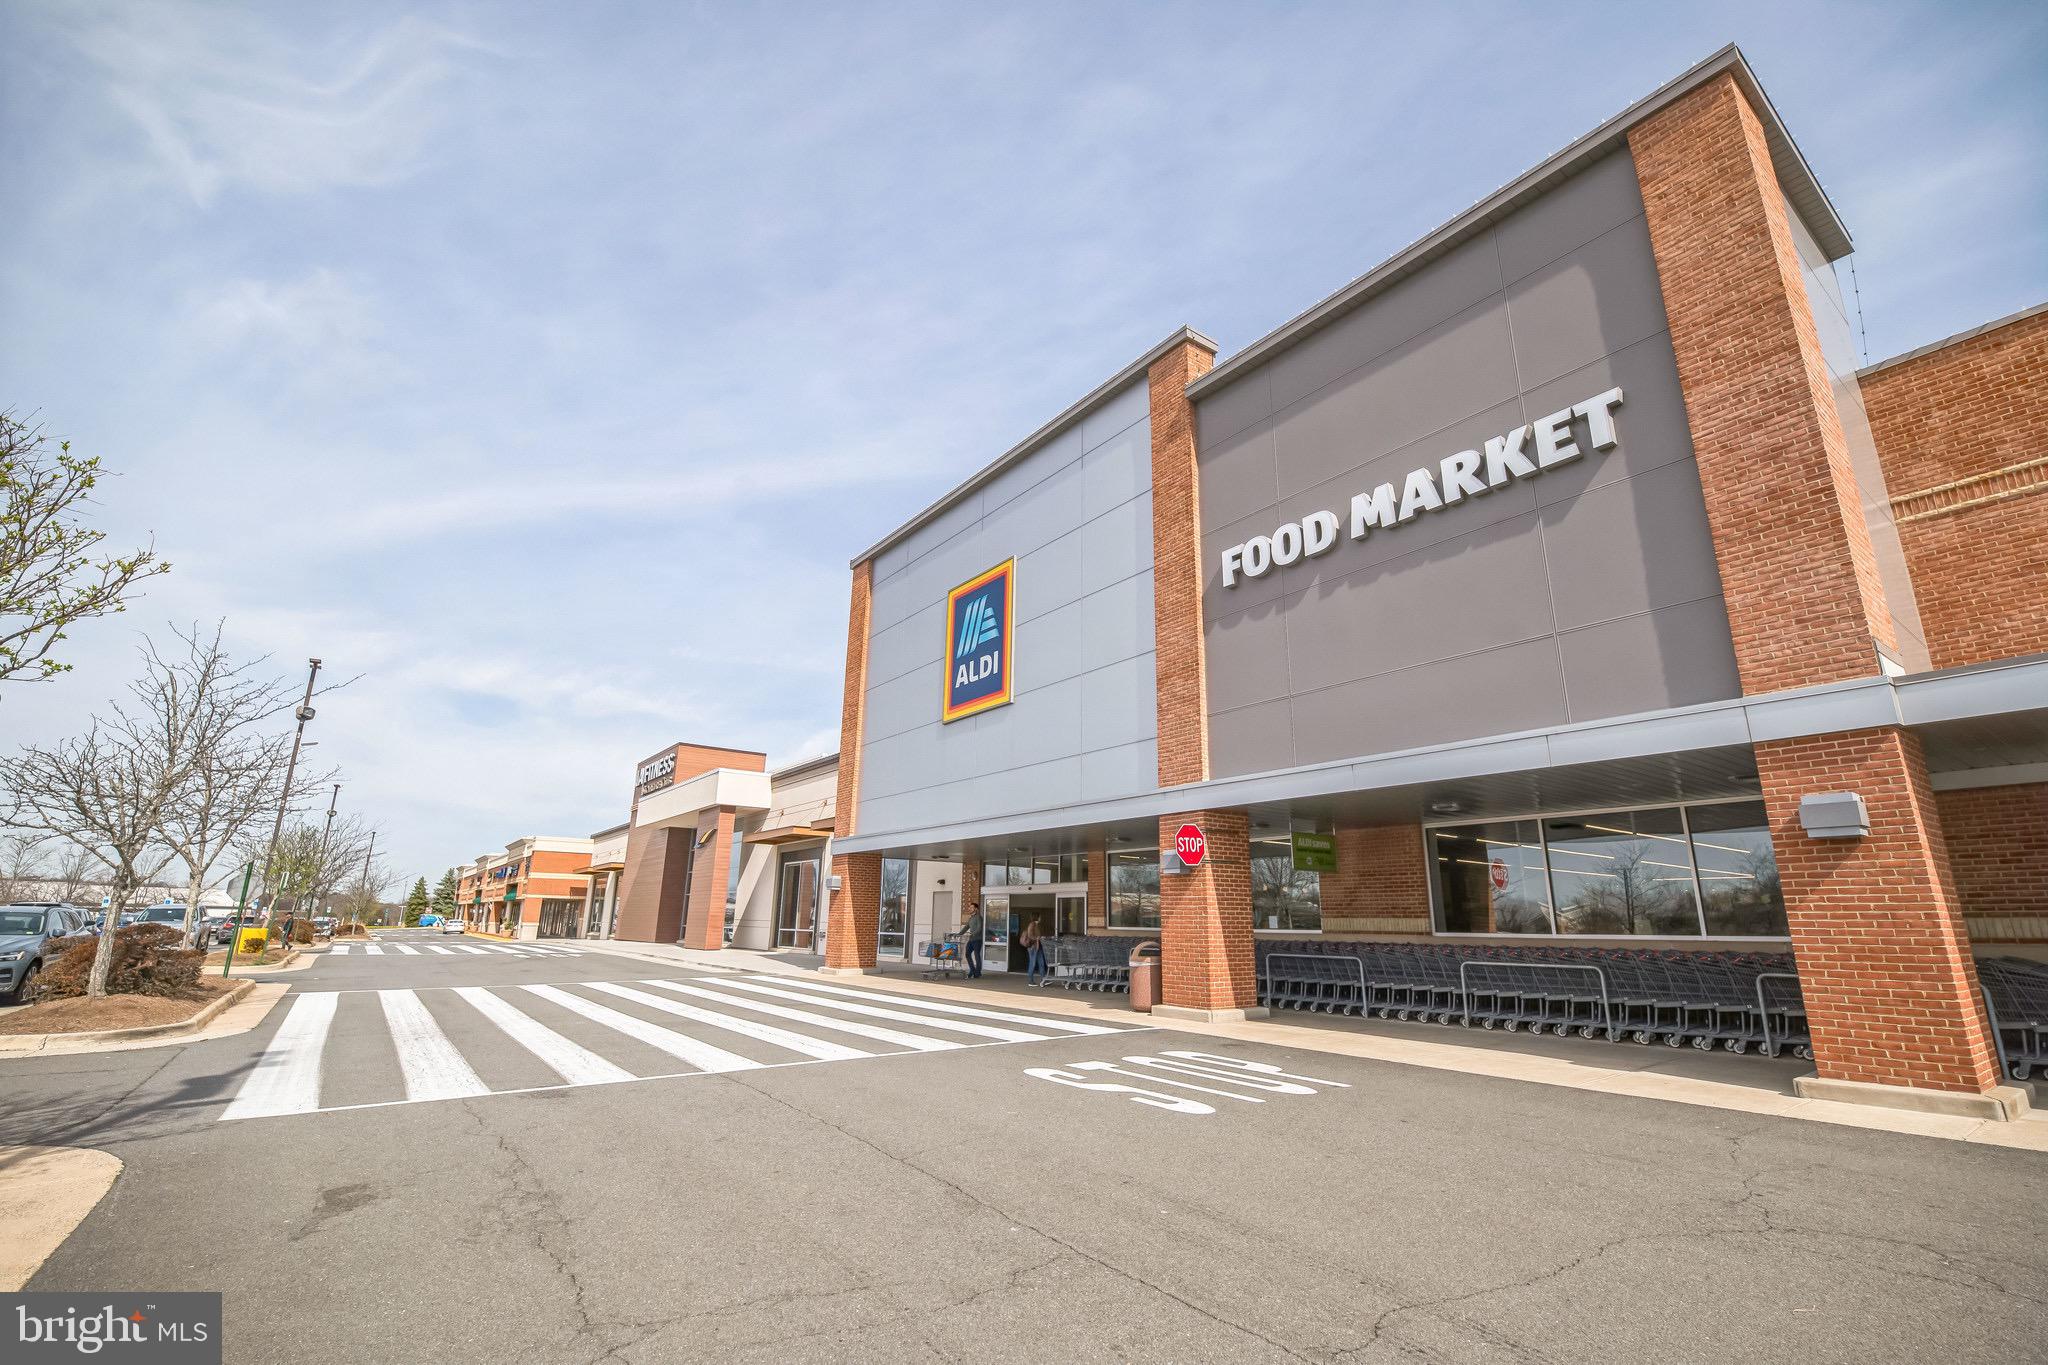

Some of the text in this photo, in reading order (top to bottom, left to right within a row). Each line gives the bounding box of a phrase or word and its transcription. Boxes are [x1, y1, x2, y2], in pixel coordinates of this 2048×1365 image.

[1221, 386, 1623, 588] FOOD MARKET
[955, 650, 999, 688] ALDI
[643, 752, 676, 782] FITNESS
[1178, 837, 1203, 853] STOP
[1023, 1051, 1352, 1114] STOP
